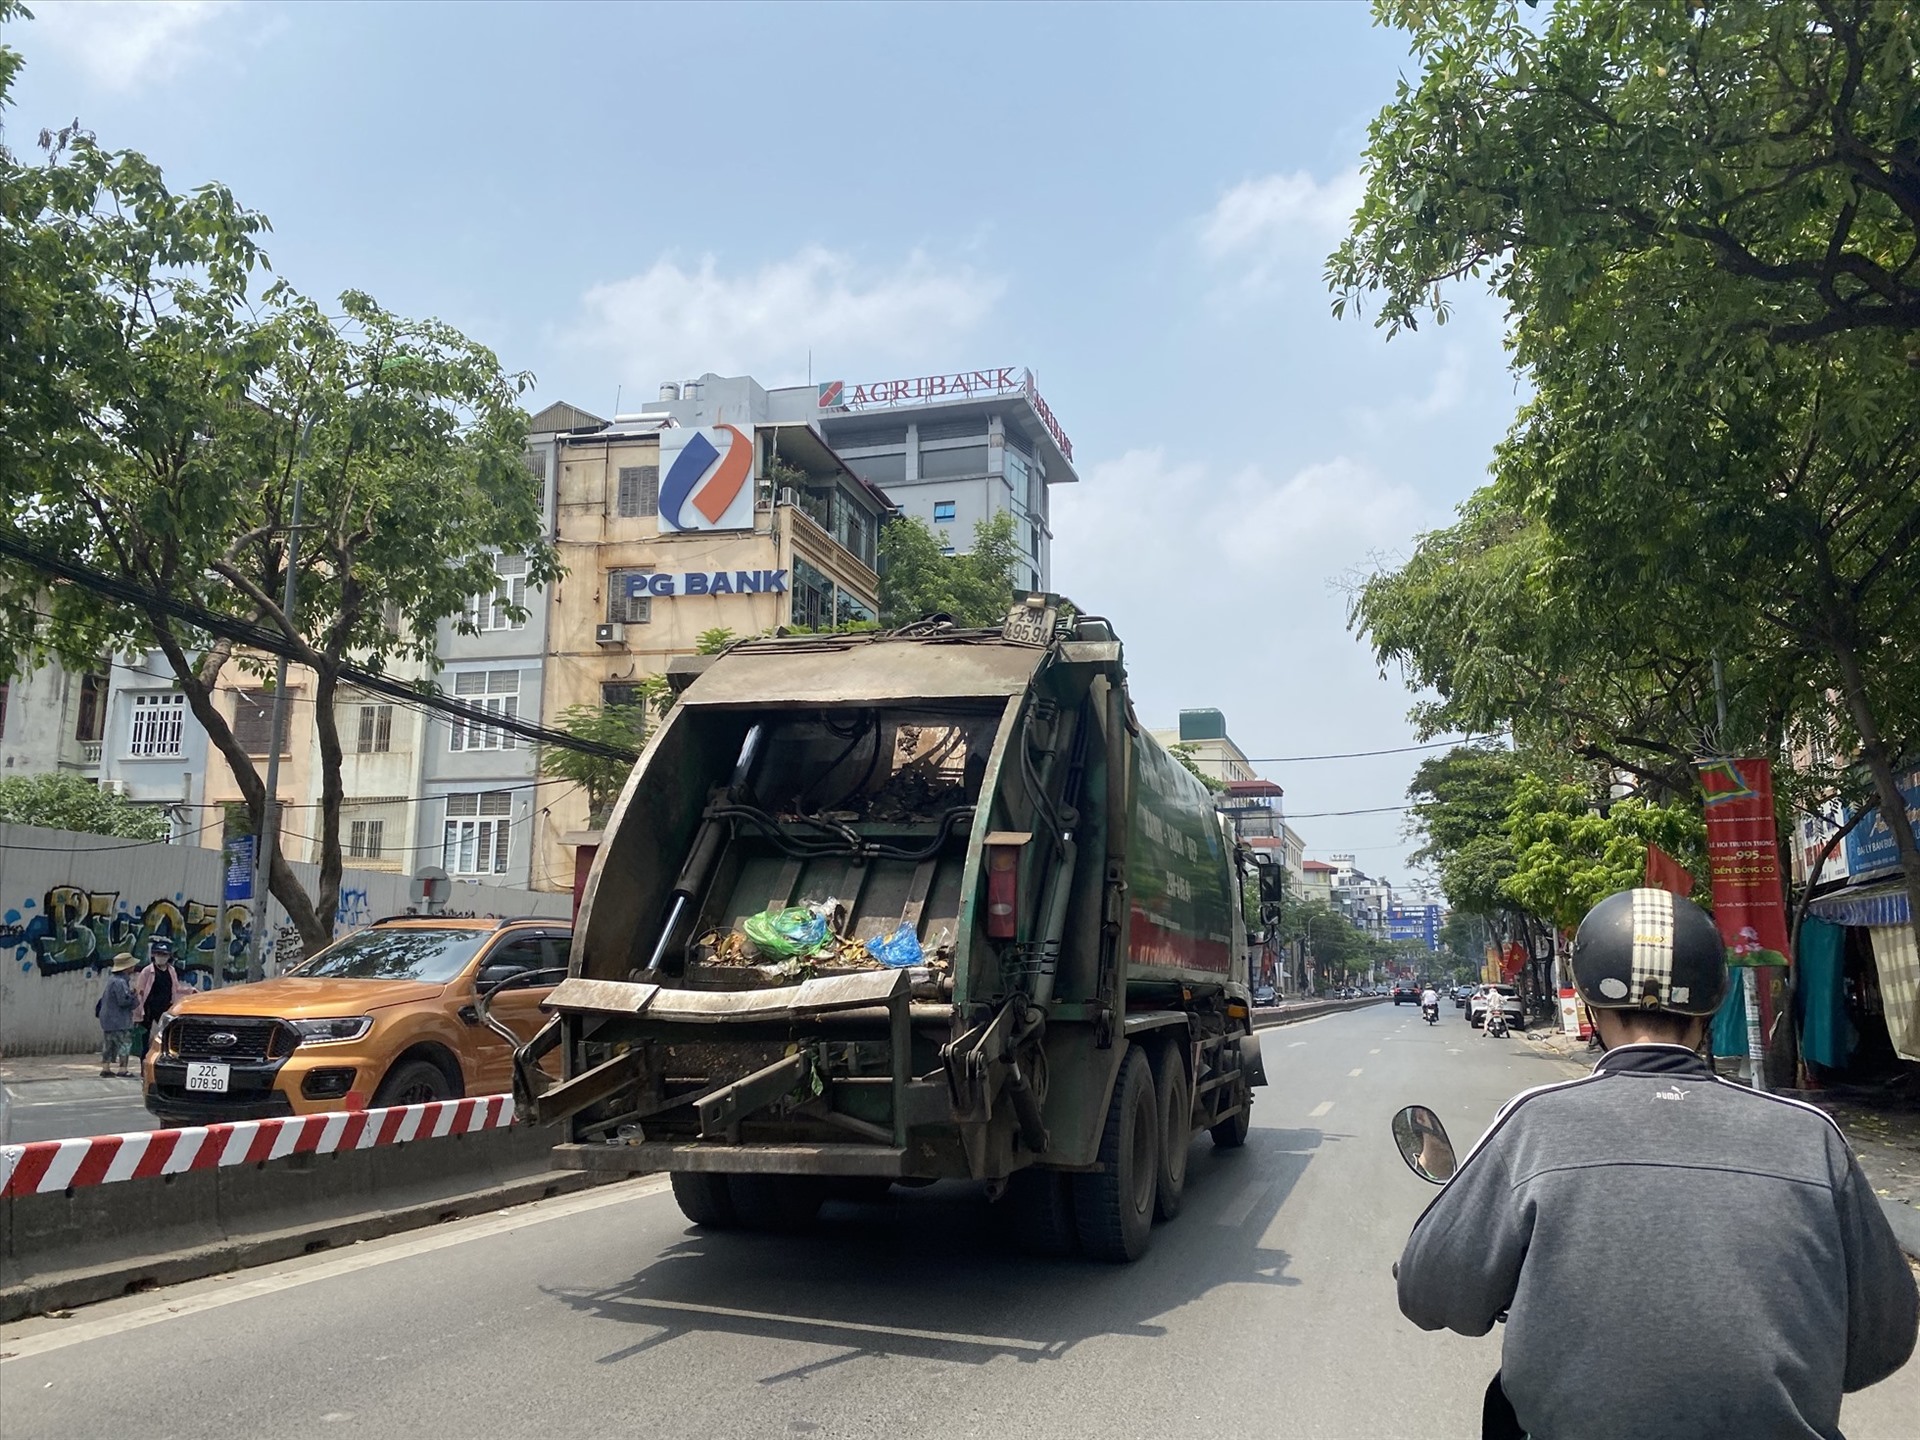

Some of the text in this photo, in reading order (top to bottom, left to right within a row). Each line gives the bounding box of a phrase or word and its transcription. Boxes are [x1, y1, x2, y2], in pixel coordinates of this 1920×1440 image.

[851, 367, 1017, 404] AGRIBANK
[626, 569, 788, 598] PG BANK
[1004, 622, 1049, 645] 495.94
[1736, 850, 1760, 860] 995
[198, 1066, 218, 1077] 22C
[190, 1077, 224, 1090] 078.90
